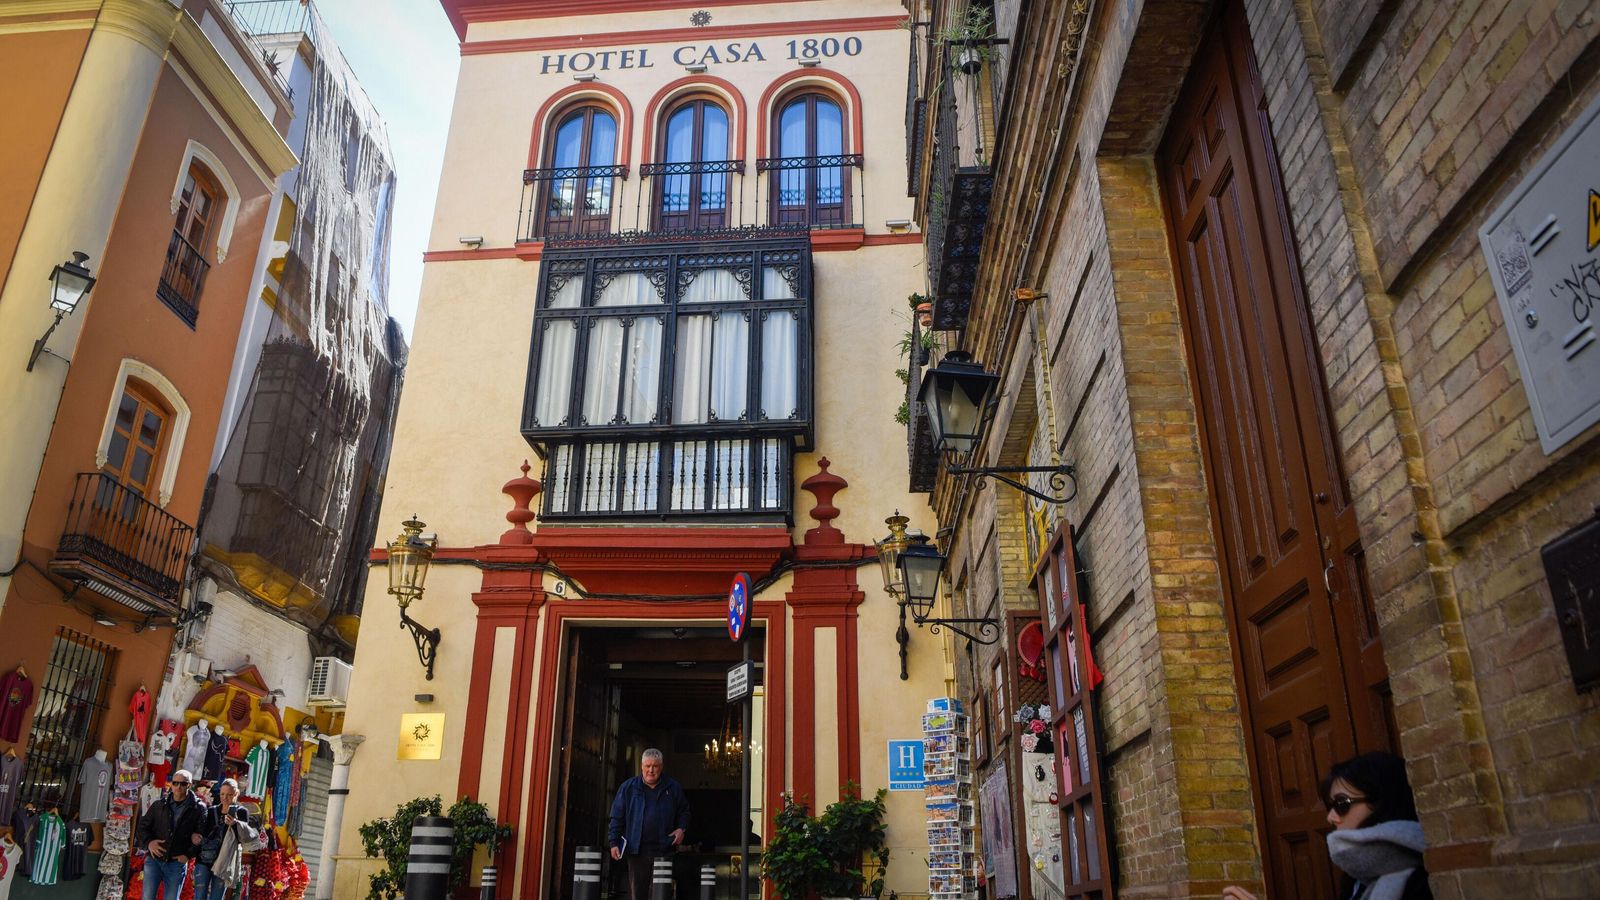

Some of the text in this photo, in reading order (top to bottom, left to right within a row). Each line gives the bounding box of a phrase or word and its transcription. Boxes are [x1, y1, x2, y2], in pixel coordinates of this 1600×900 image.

[539, 36, 863, 75] HOTEL CASA 1800
[555, 582, 563, 593] 6
[897, 745, 916, 768] H
